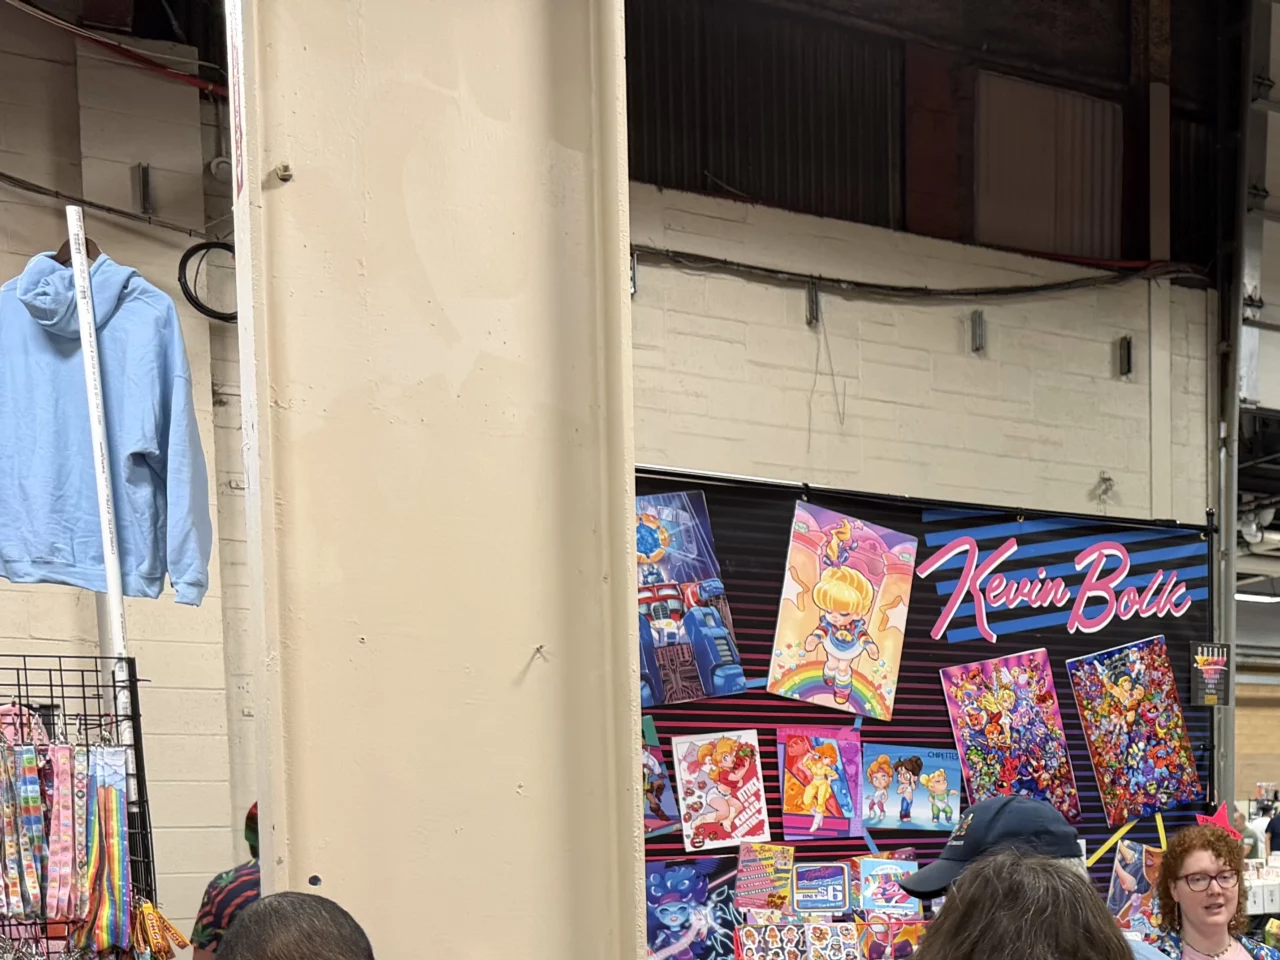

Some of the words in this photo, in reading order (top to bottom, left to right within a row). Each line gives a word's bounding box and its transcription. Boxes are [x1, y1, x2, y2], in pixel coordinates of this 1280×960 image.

[916, 536, 1071, 643] Kevin
[1067, 541, 1192, 634] Bolk
[927, 751, 960, 761] CHIPETTES
[818, 885, 843, 901] $6
